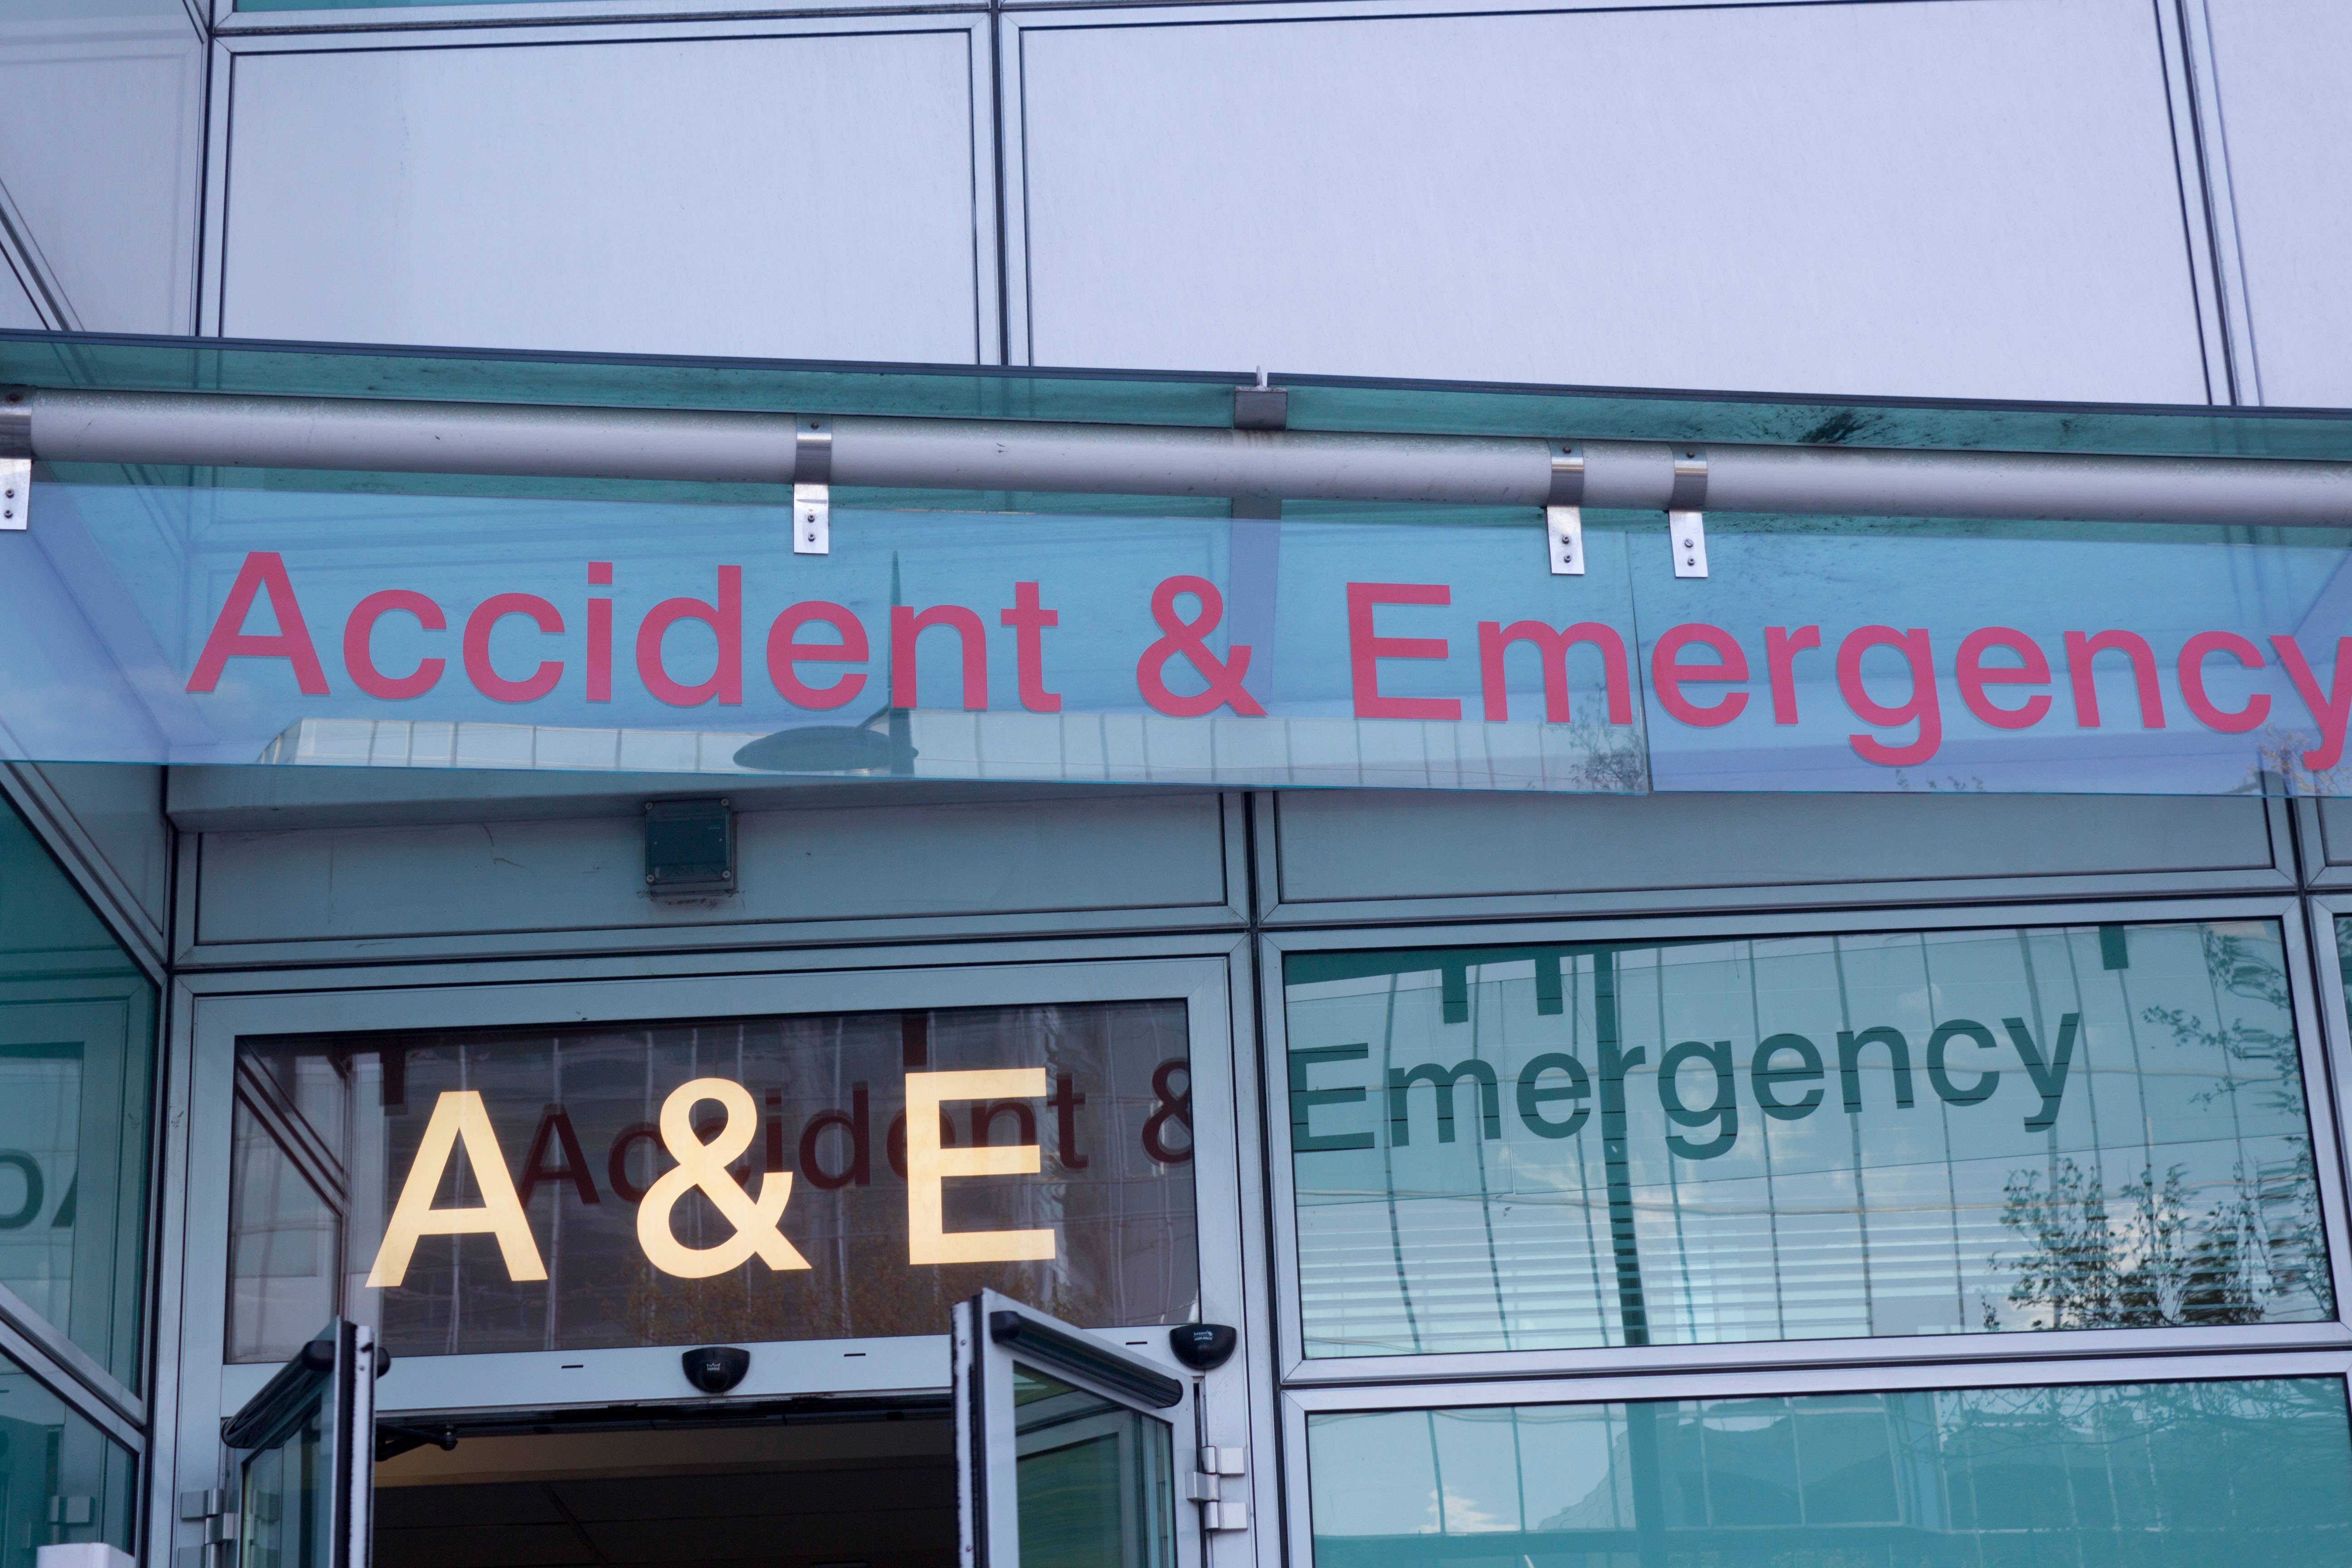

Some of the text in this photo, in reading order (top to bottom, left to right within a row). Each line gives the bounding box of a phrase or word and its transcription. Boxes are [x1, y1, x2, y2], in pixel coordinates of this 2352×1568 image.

[186, 552, 2352, 771] Accident & Emergency
[365, 1067, 1056, 1288] A & E
[1289, 1013, 2080, 1159] Emergency
